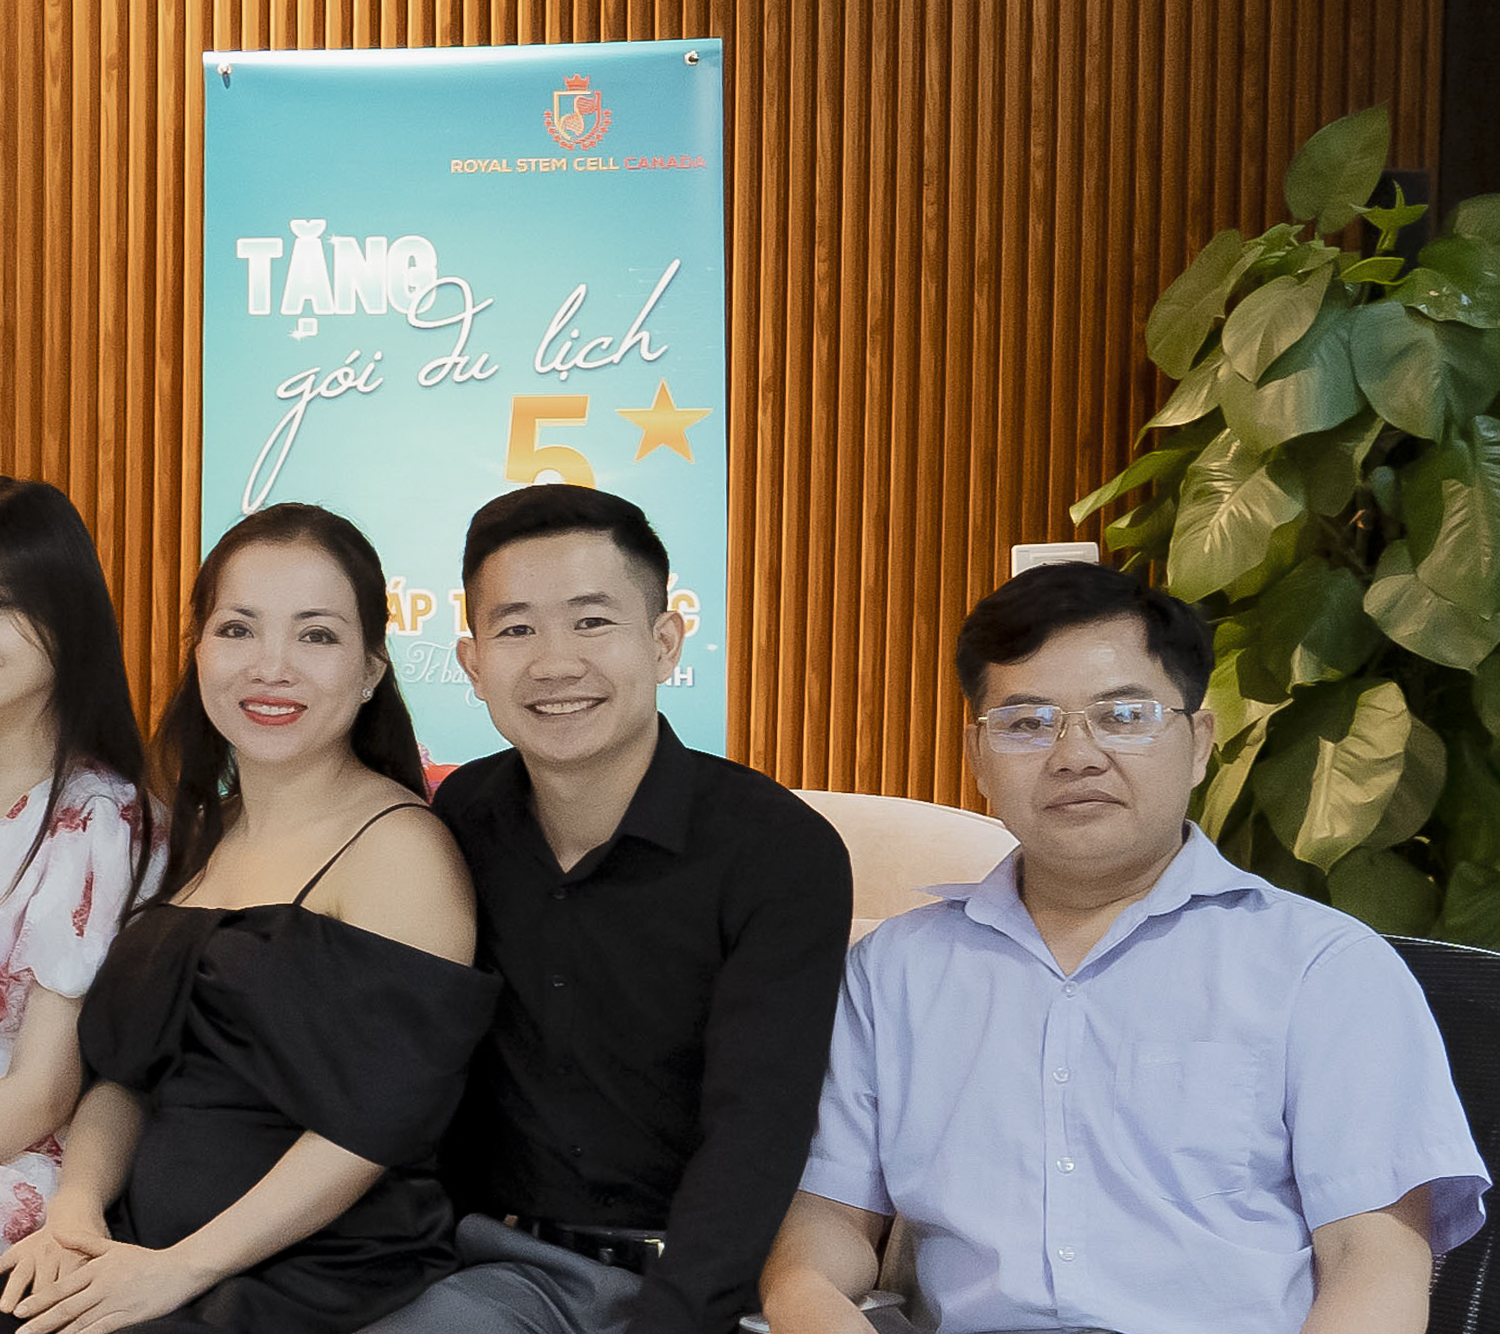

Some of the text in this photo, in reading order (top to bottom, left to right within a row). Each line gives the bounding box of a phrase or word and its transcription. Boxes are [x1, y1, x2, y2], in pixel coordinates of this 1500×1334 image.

[450, 155, 706, 174] ROYAL STEM CELL CANADA
[236, 219, 438, 339] TẶNG
[241, 258, 683, 516] gói du lịch
[504, 394, 597, 489] 5
